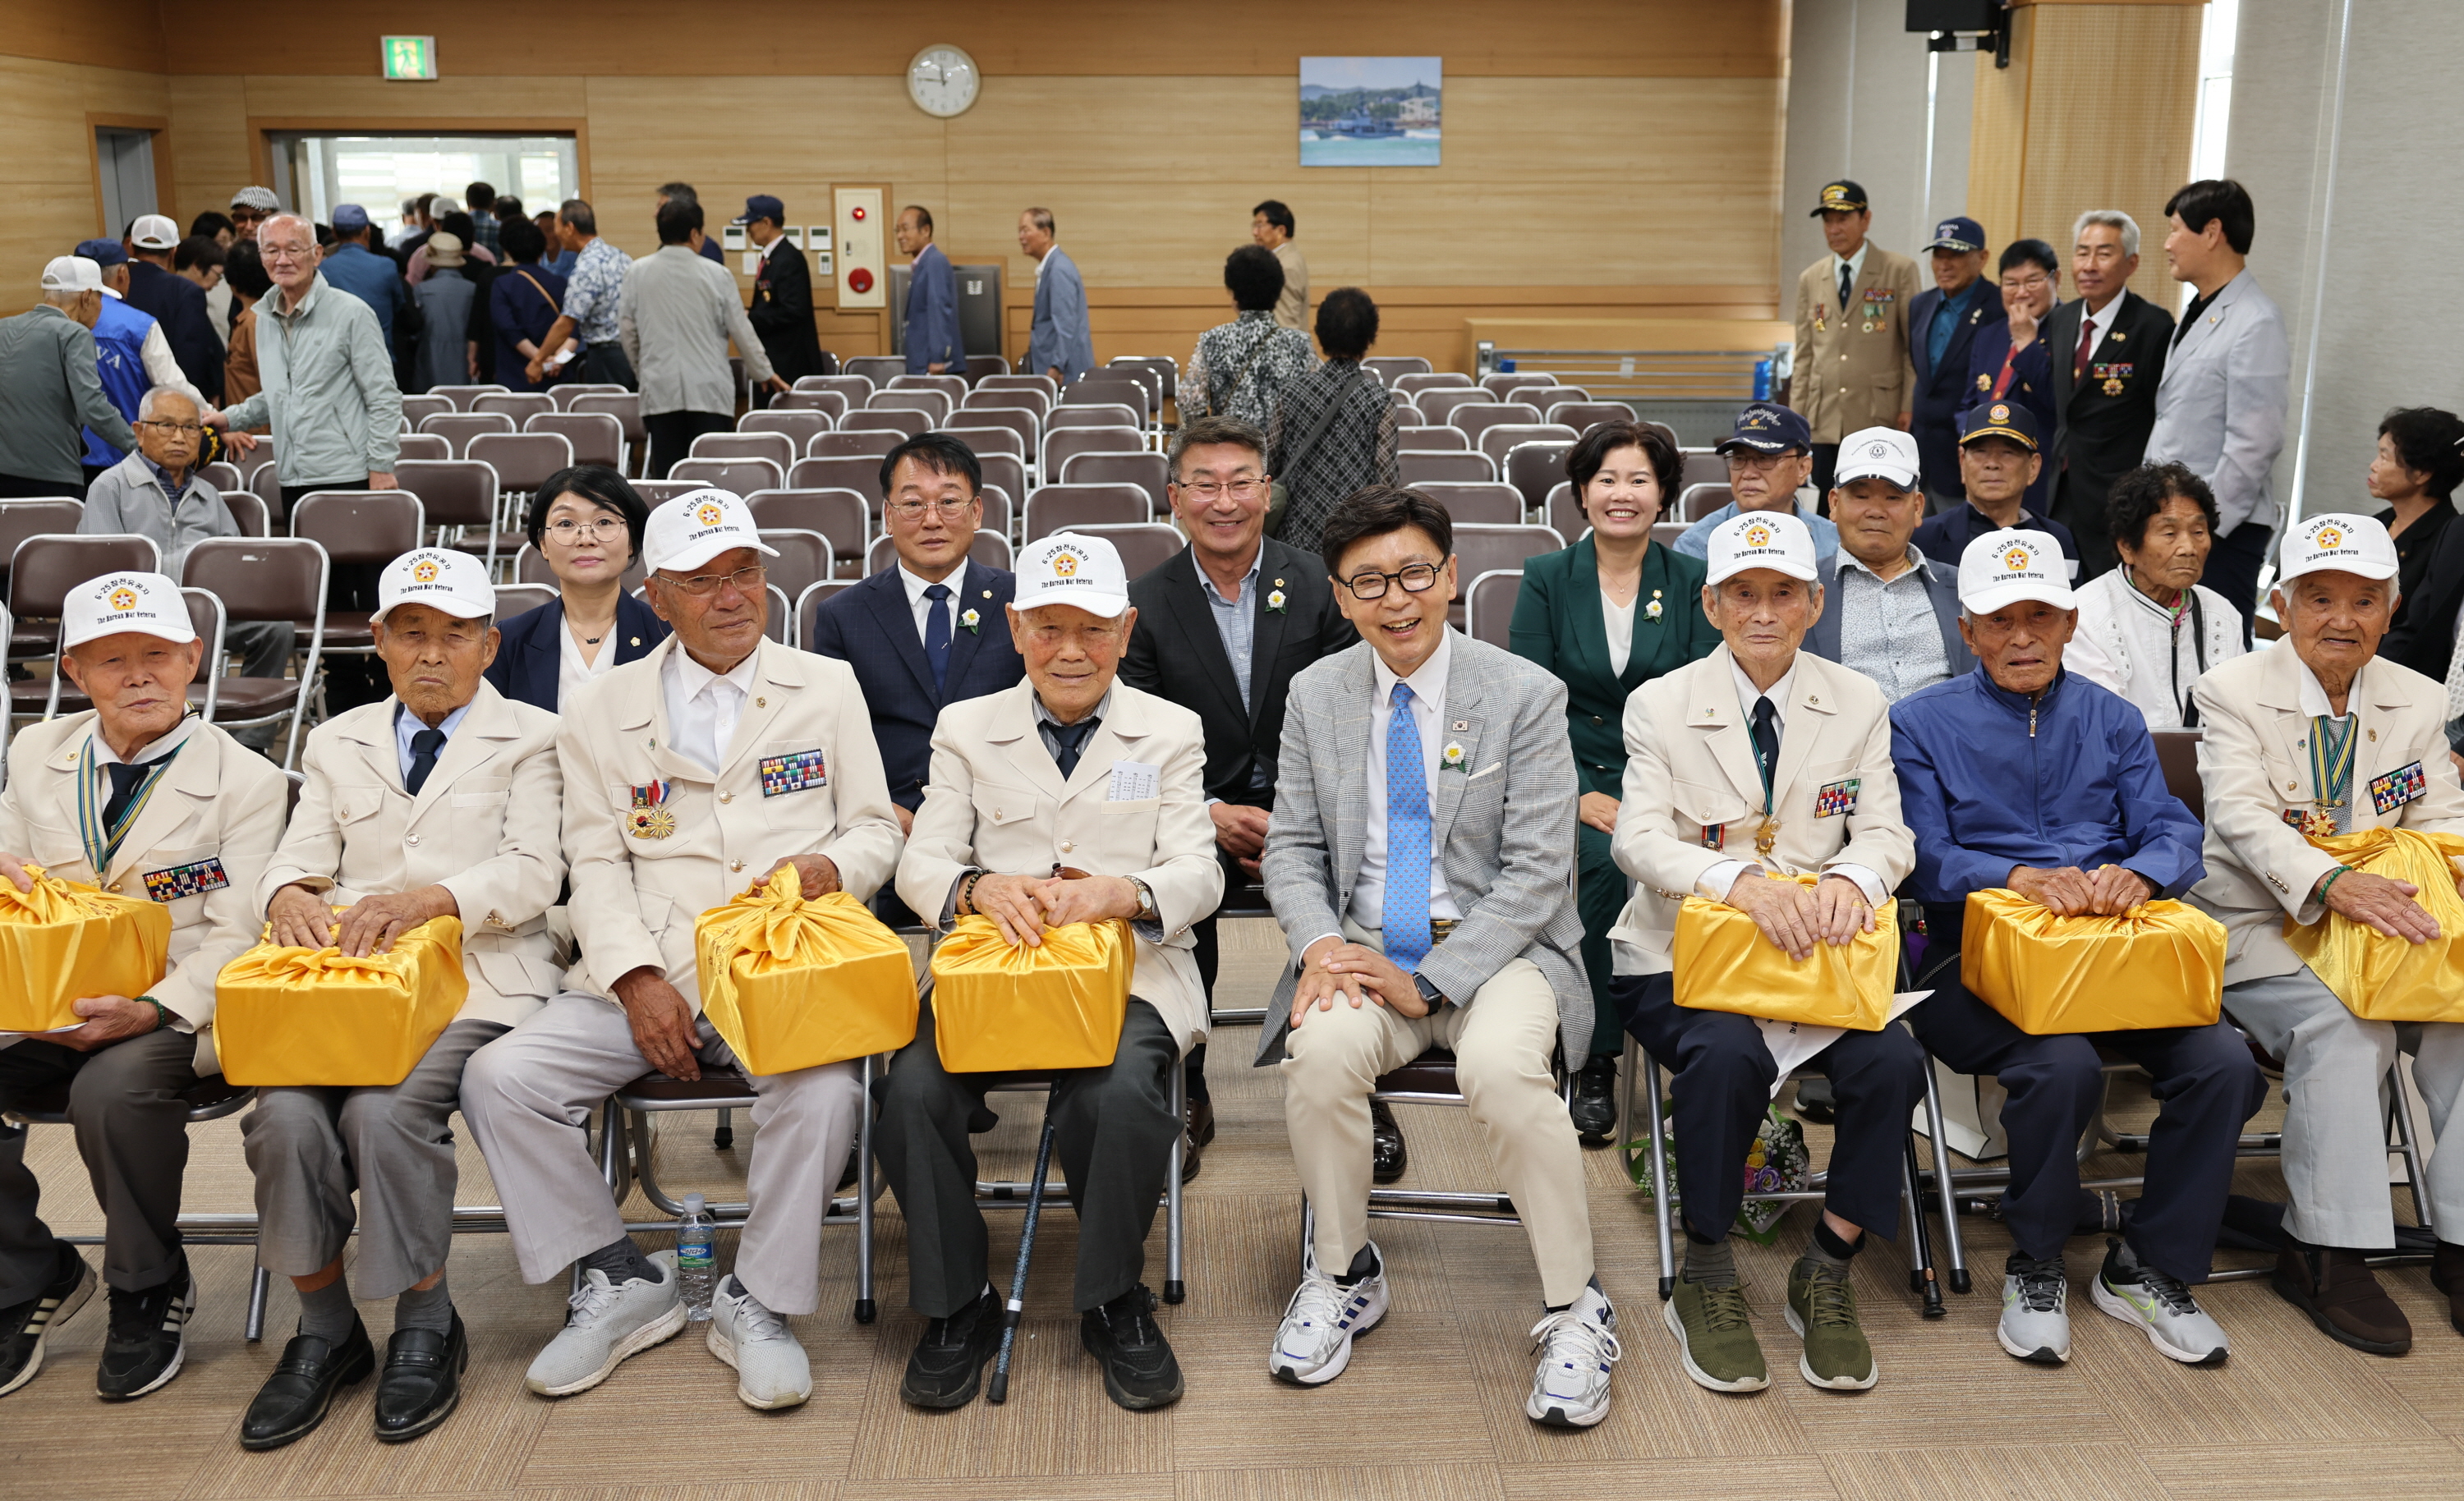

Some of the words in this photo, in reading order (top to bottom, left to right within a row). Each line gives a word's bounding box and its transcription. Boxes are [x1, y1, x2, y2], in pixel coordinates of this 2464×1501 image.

[697, 528, 714, 538] Korean
[1741, 549, 1757, 557] Korean
[2313, 551, 2328, 559] Korean
[434, 584, 453, 592] Veteran
[106, 613, 124, 622] Korean
